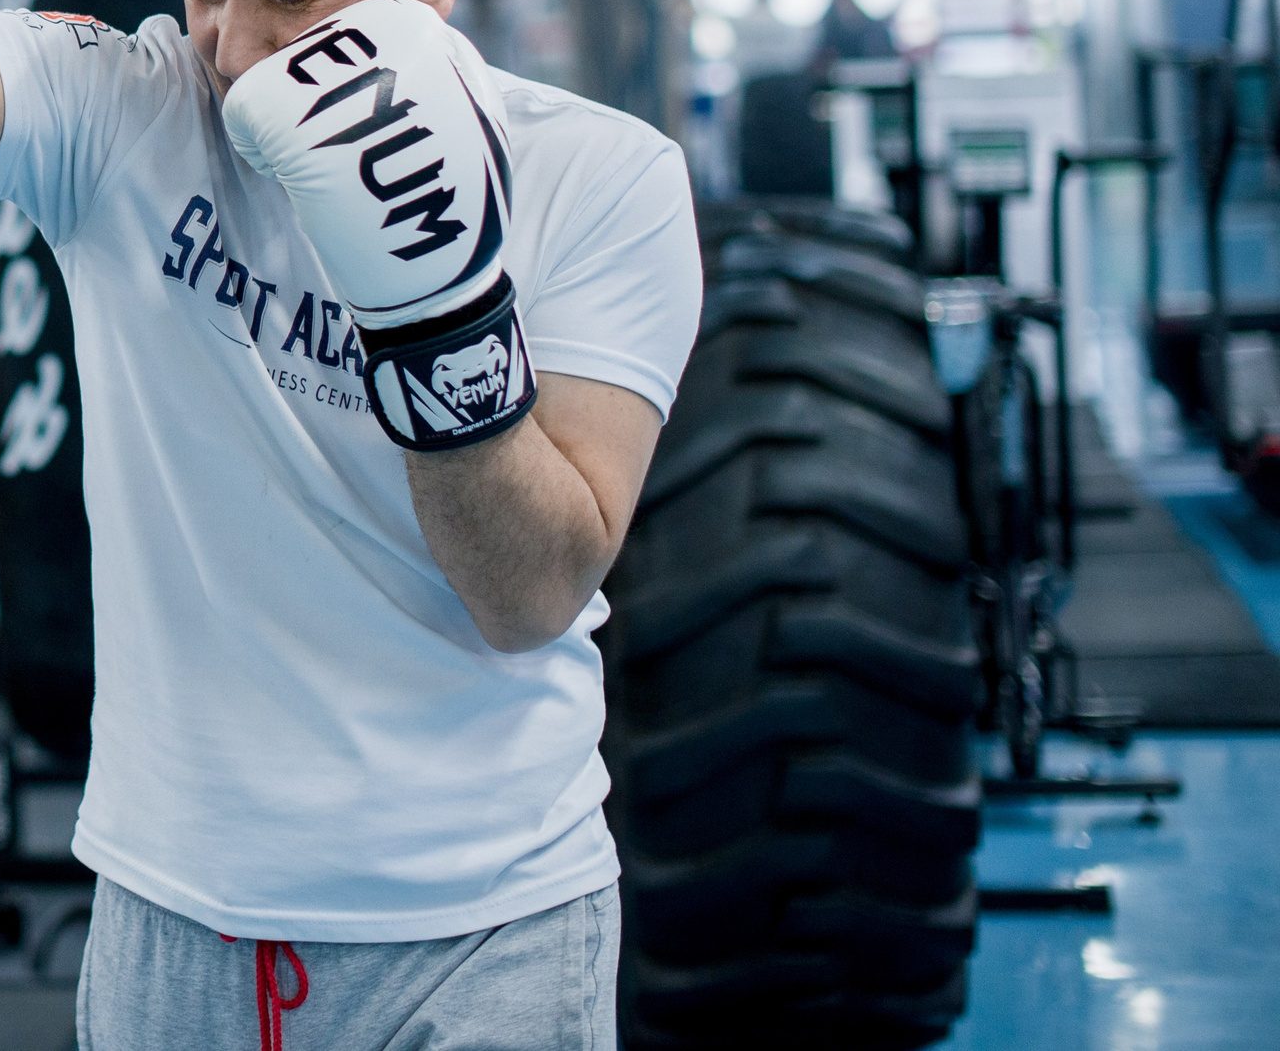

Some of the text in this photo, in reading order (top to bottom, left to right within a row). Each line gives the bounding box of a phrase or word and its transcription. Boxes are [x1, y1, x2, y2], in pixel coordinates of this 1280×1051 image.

[286, 18, 469, 262] ENUM
[443, 370, 506, 409] VENUM
[452, 419, 484, 436] Designed
[492, 402, 518, 421] Thailand
